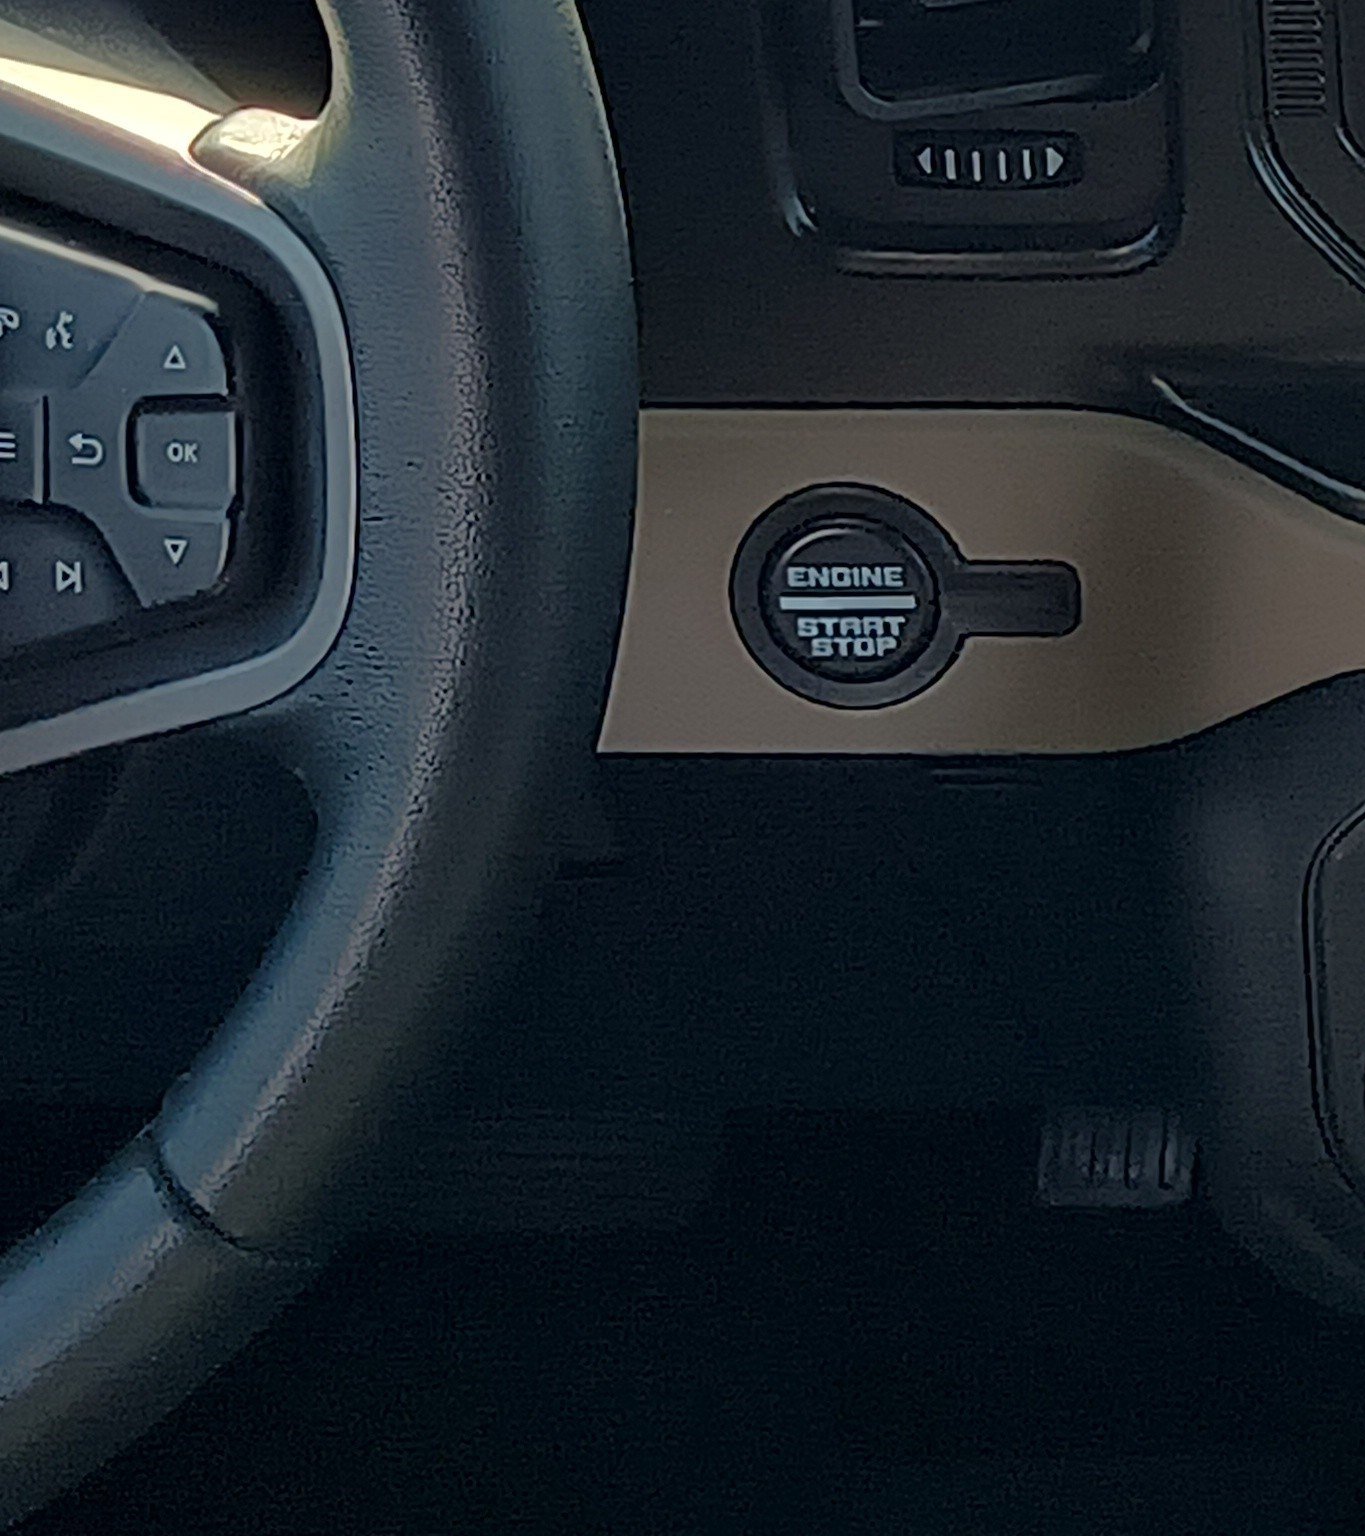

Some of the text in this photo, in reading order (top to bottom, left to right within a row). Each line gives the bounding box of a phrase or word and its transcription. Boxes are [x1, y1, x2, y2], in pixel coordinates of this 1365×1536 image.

[166, 442, 199, 463] OK
[786, 566, 904, 588] ENGINE
[796, 616, 906, 638] START
[811, 636, 898, 658] STOP
